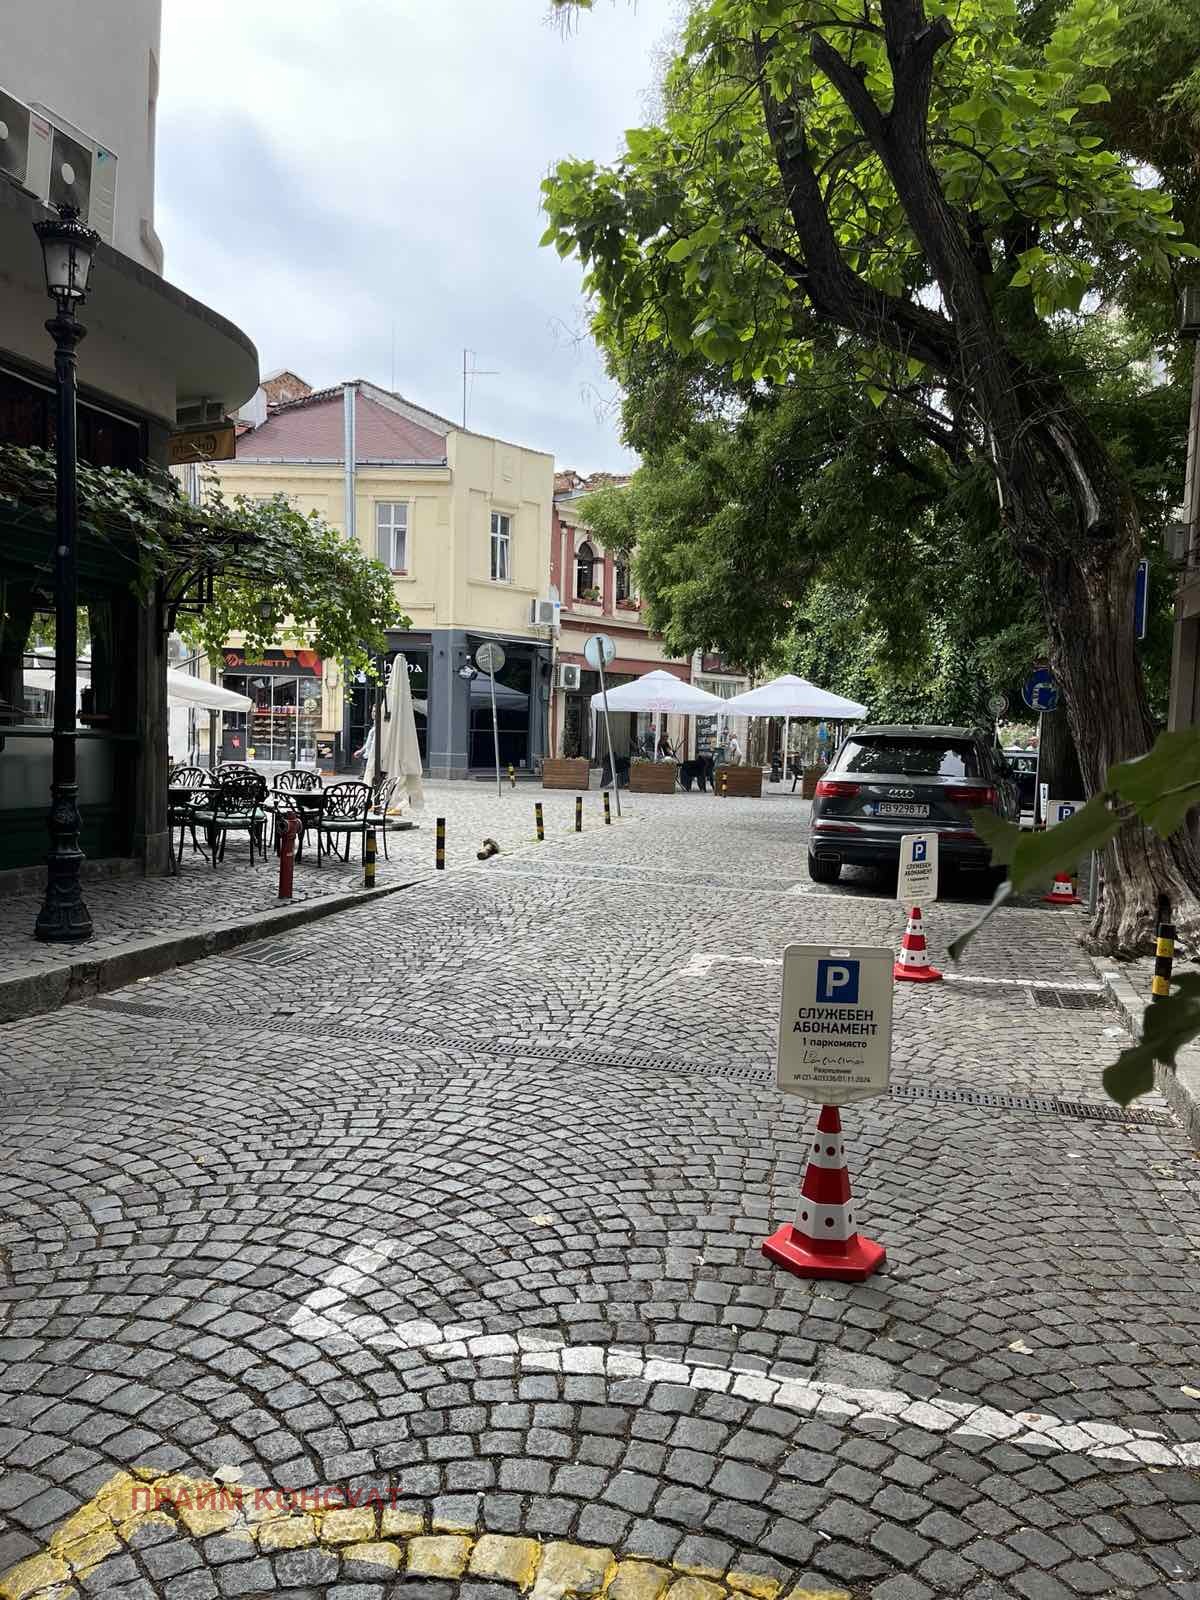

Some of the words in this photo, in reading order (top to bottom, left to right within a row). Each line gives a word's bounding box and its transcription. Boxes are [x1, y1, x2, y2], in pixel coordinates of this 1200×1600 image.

[915, 843, 924, 859] P
[826, 966, 850, 997] P
[798, 1007, 873, 1021] СЛУЖЕБЕН
[793, 1021, 878, 1035] АБОНАМЕНТ
[802, 1037, 807, 1046] 1
[810, 1039, 867, 1048] паркомясто
